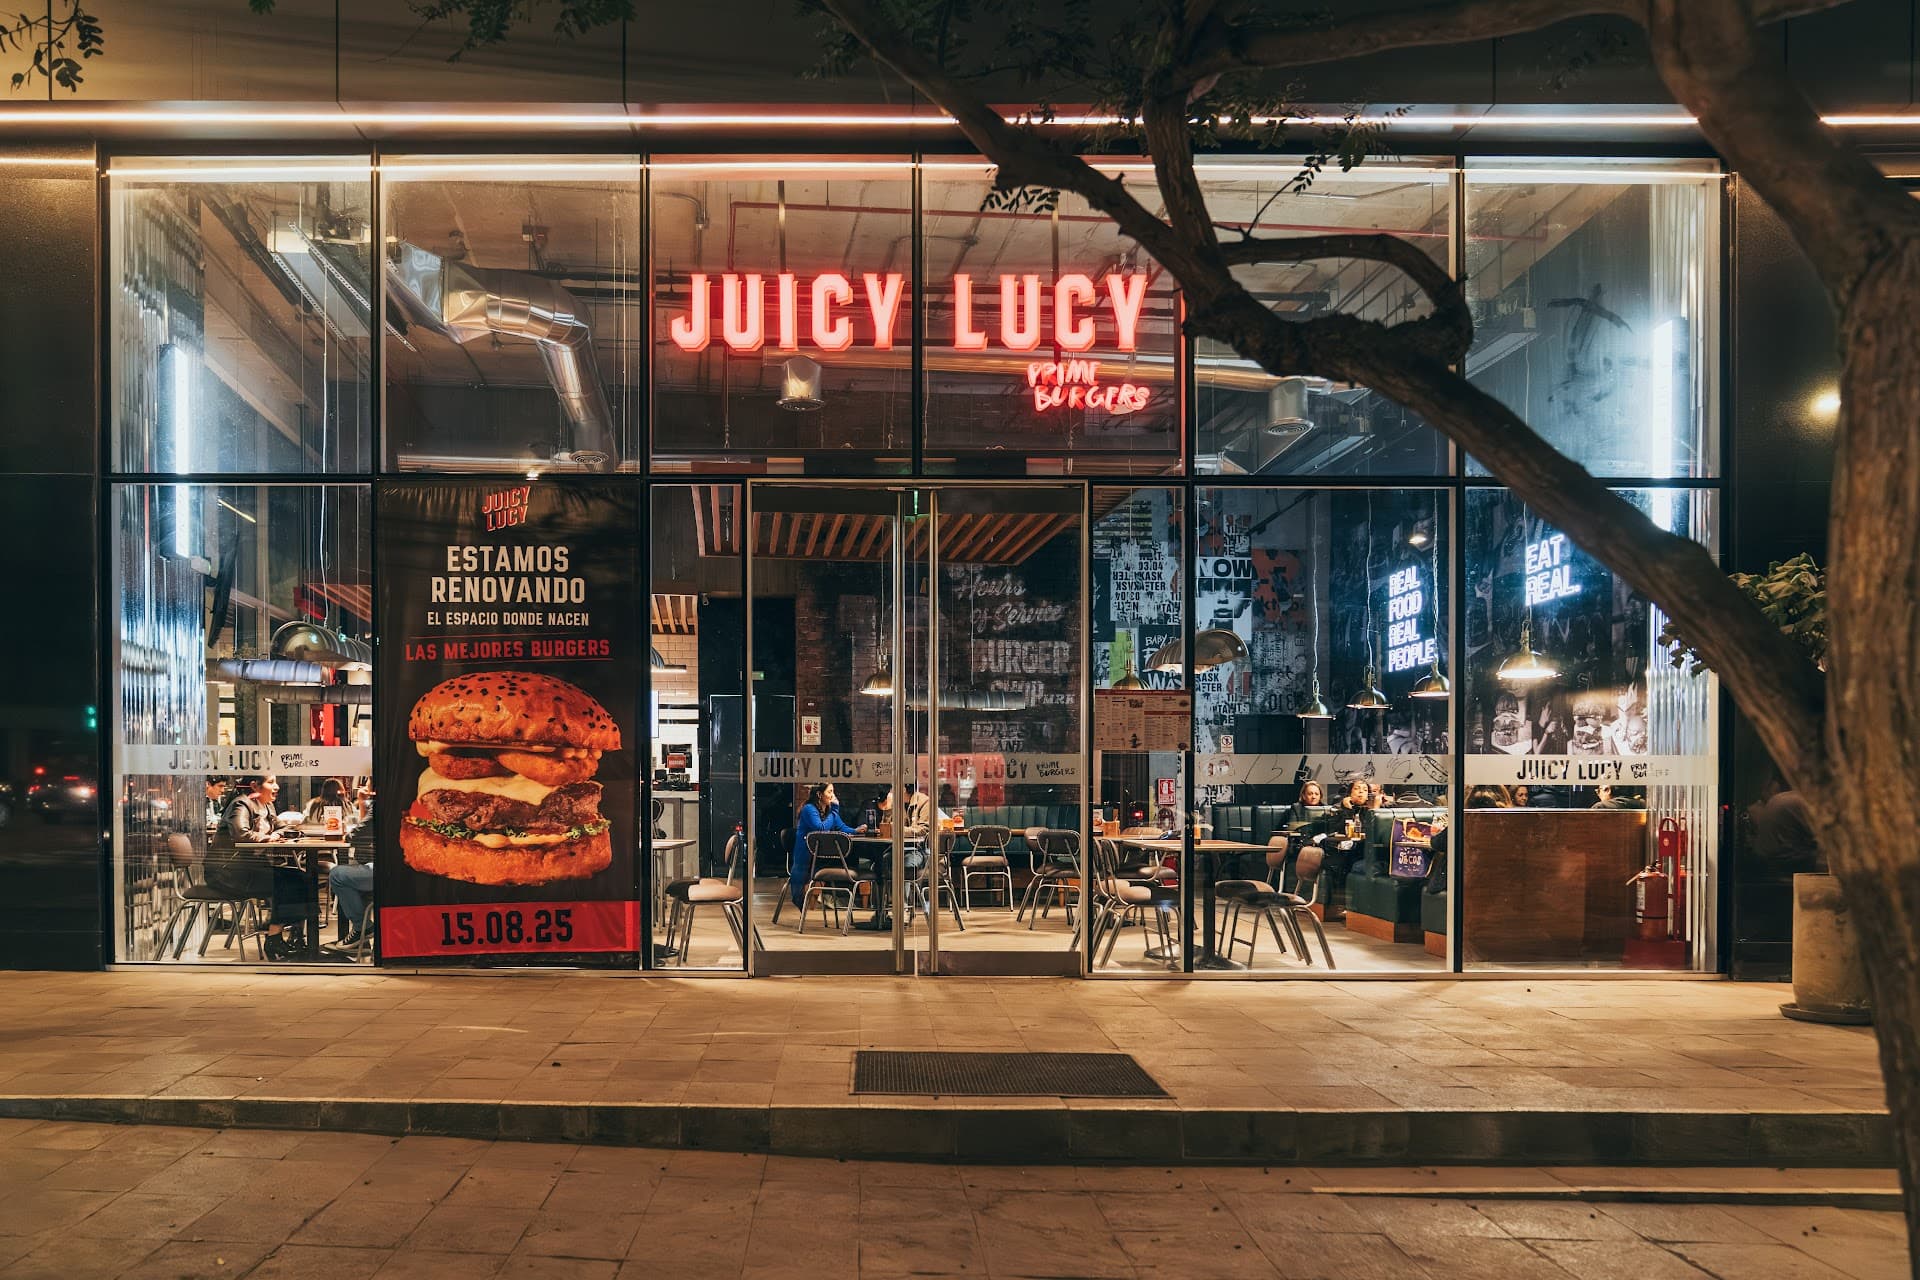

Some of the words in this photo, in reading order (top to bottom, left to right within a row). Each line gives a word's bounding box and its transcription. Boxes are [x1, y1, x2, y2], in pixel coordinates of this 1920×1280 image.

[671, 273, 906, 352] JUICY
[954, 273, 1149, 352] LUCY
[1027, 360, 1101, 388] PRIME
[1034, 383, 1151, 412] BURGERS
[482, 486, 531, 514] JUICY
[486, 505, 529, 532] LUCY
[447, 545, 569, 573] ESTAMOS
[1525, 533, 1565, 575] EAT
[431, 577, 586, 604] RENOVANDO
[1388, 565, 1421, 598] REAL
[1525, 565, 1582, 607] REAL.
[427, 611, 441, 626] EL
[446, 611, 498, 627] ESPACIO
[503, 612, 543, 626] DONDE
[548, 612, 589, 627] NACEN
[1388, 590, 1423, 622] FOOD
[1388, 618, 1420, 648] REAL
[405, 644, 437, 661] LAS
[444, 640, 523, 660] MEJORES
[531, 639, 610, 657] BURGERS
[229, 750, 274, 770] LUCY
[758, 757, 812, 778] JUICY
[819, 758, 864, 778] LUCY
[983, 757, 1028, 778] LUCY
[1516, 760, 1570, 780] JUICY
[1578, 760, 1622, 780] LUCY
[441, 909, 574, 946] 15.08.25
